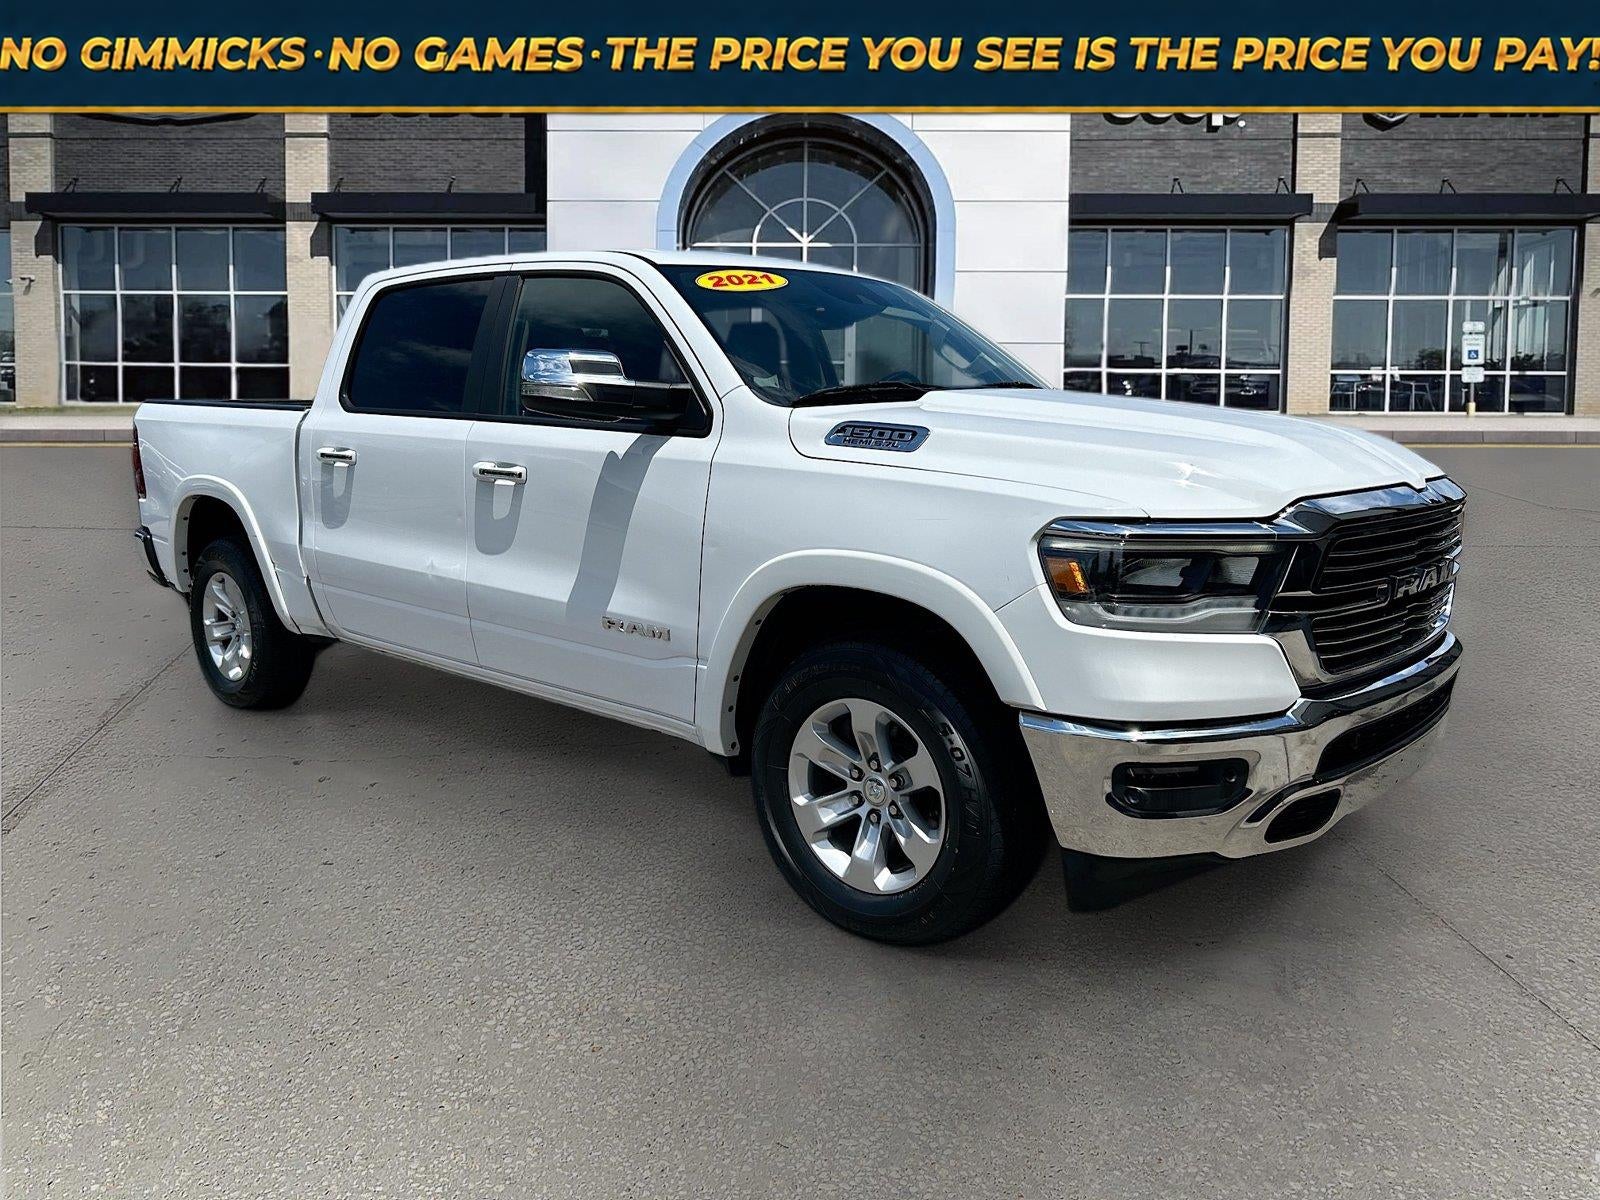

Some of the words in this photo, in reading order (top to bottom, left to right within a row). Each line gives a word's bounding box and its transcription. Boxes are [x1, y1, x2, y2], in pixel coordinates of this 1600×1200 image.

[707, 273, 776, 288] 2021
[834, 425, 915, 441] 1500
[1393, 559, 1459, 600] RAM
[602, 616, 671, 641] RAM
